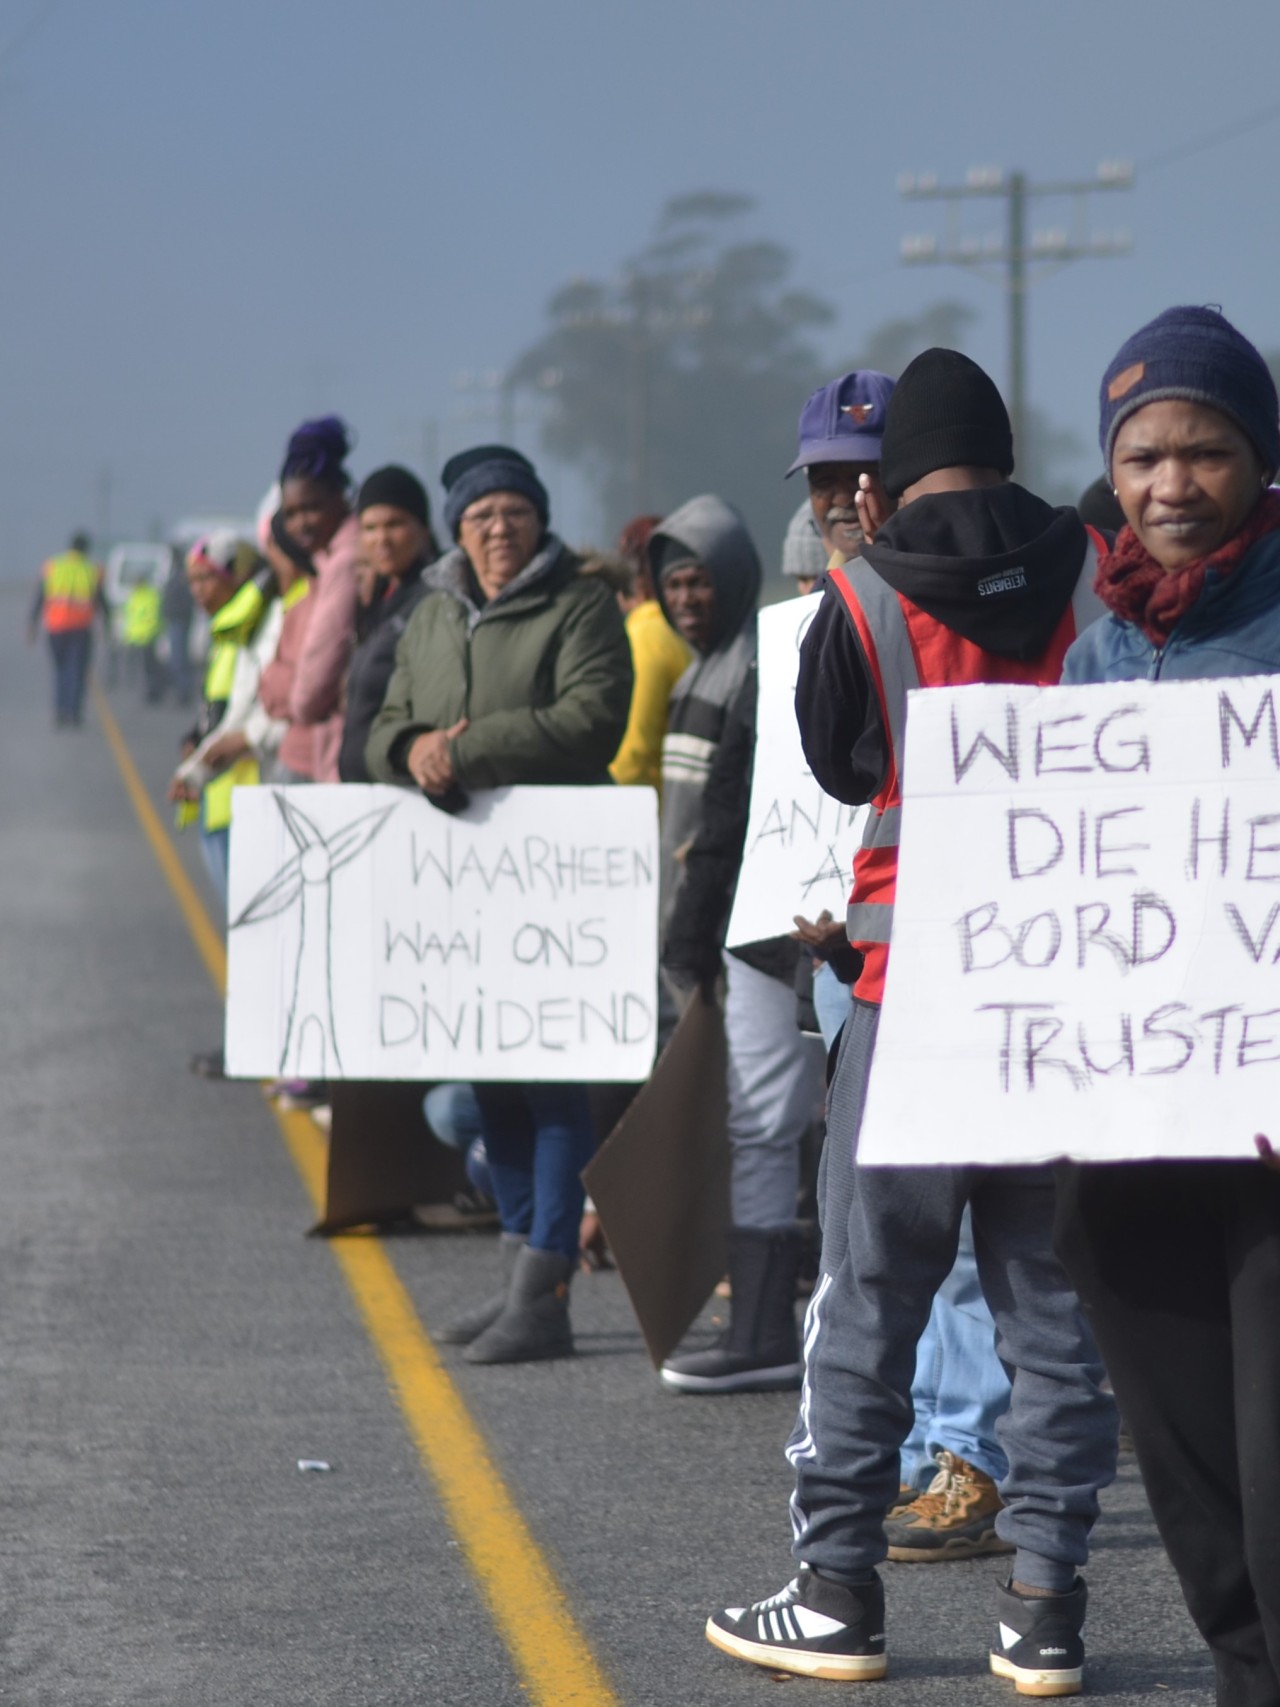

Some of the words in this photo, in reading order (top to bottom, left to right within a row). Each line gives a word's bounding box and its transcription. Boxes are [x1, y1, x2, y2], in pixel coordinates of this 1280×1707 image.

[977, 573, 1028, 596] VETEMENTS
[949, 697, 1150, 785] WEG
[410, 828, 654, 901] WAARHEEN
[1004, 802, 1152, 880] DIE
[513, 916, 608, 969] ONS
[955, 890, 1178, 975] BORD
[1040, 1646, 1067, 1655] adidas
